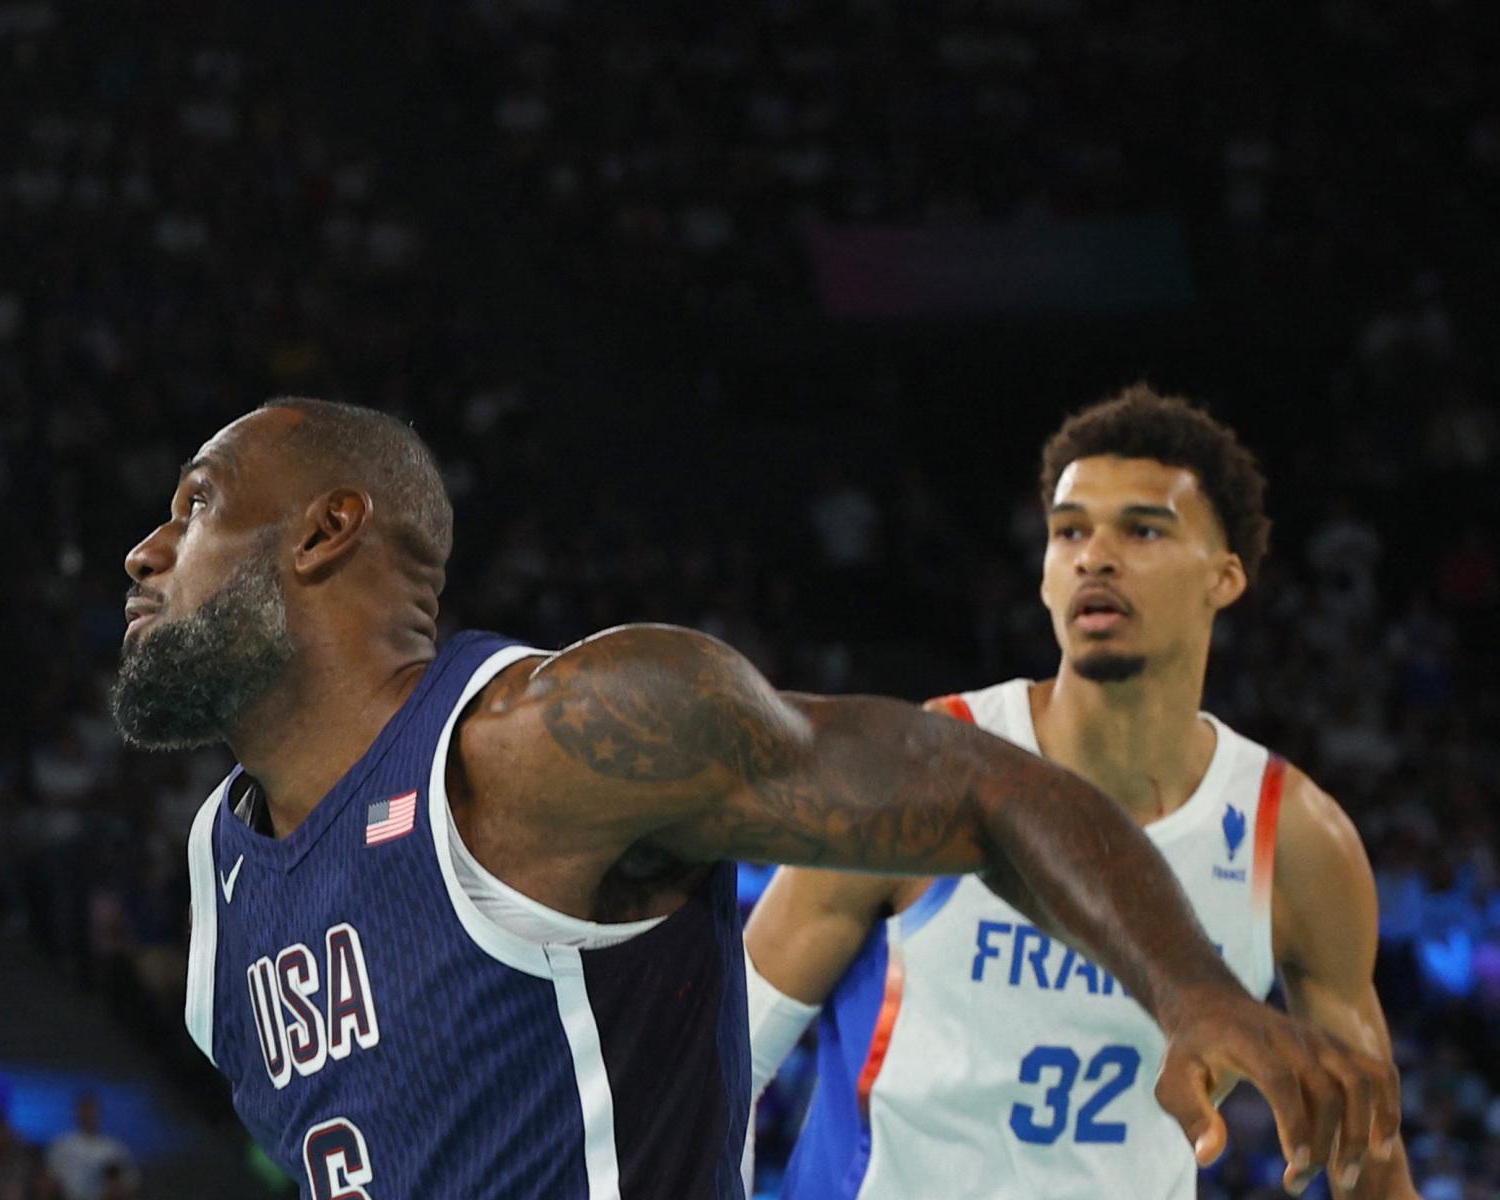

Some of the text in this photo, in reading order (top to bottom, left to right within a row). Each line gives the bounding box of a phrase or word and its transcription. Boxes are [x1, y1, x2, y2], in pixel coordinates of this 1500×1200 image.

[247, 922, 379, 1089] USA
[971, 920, 1223, 996] FRA
[1009, 1045, 1141, 1145] 32
